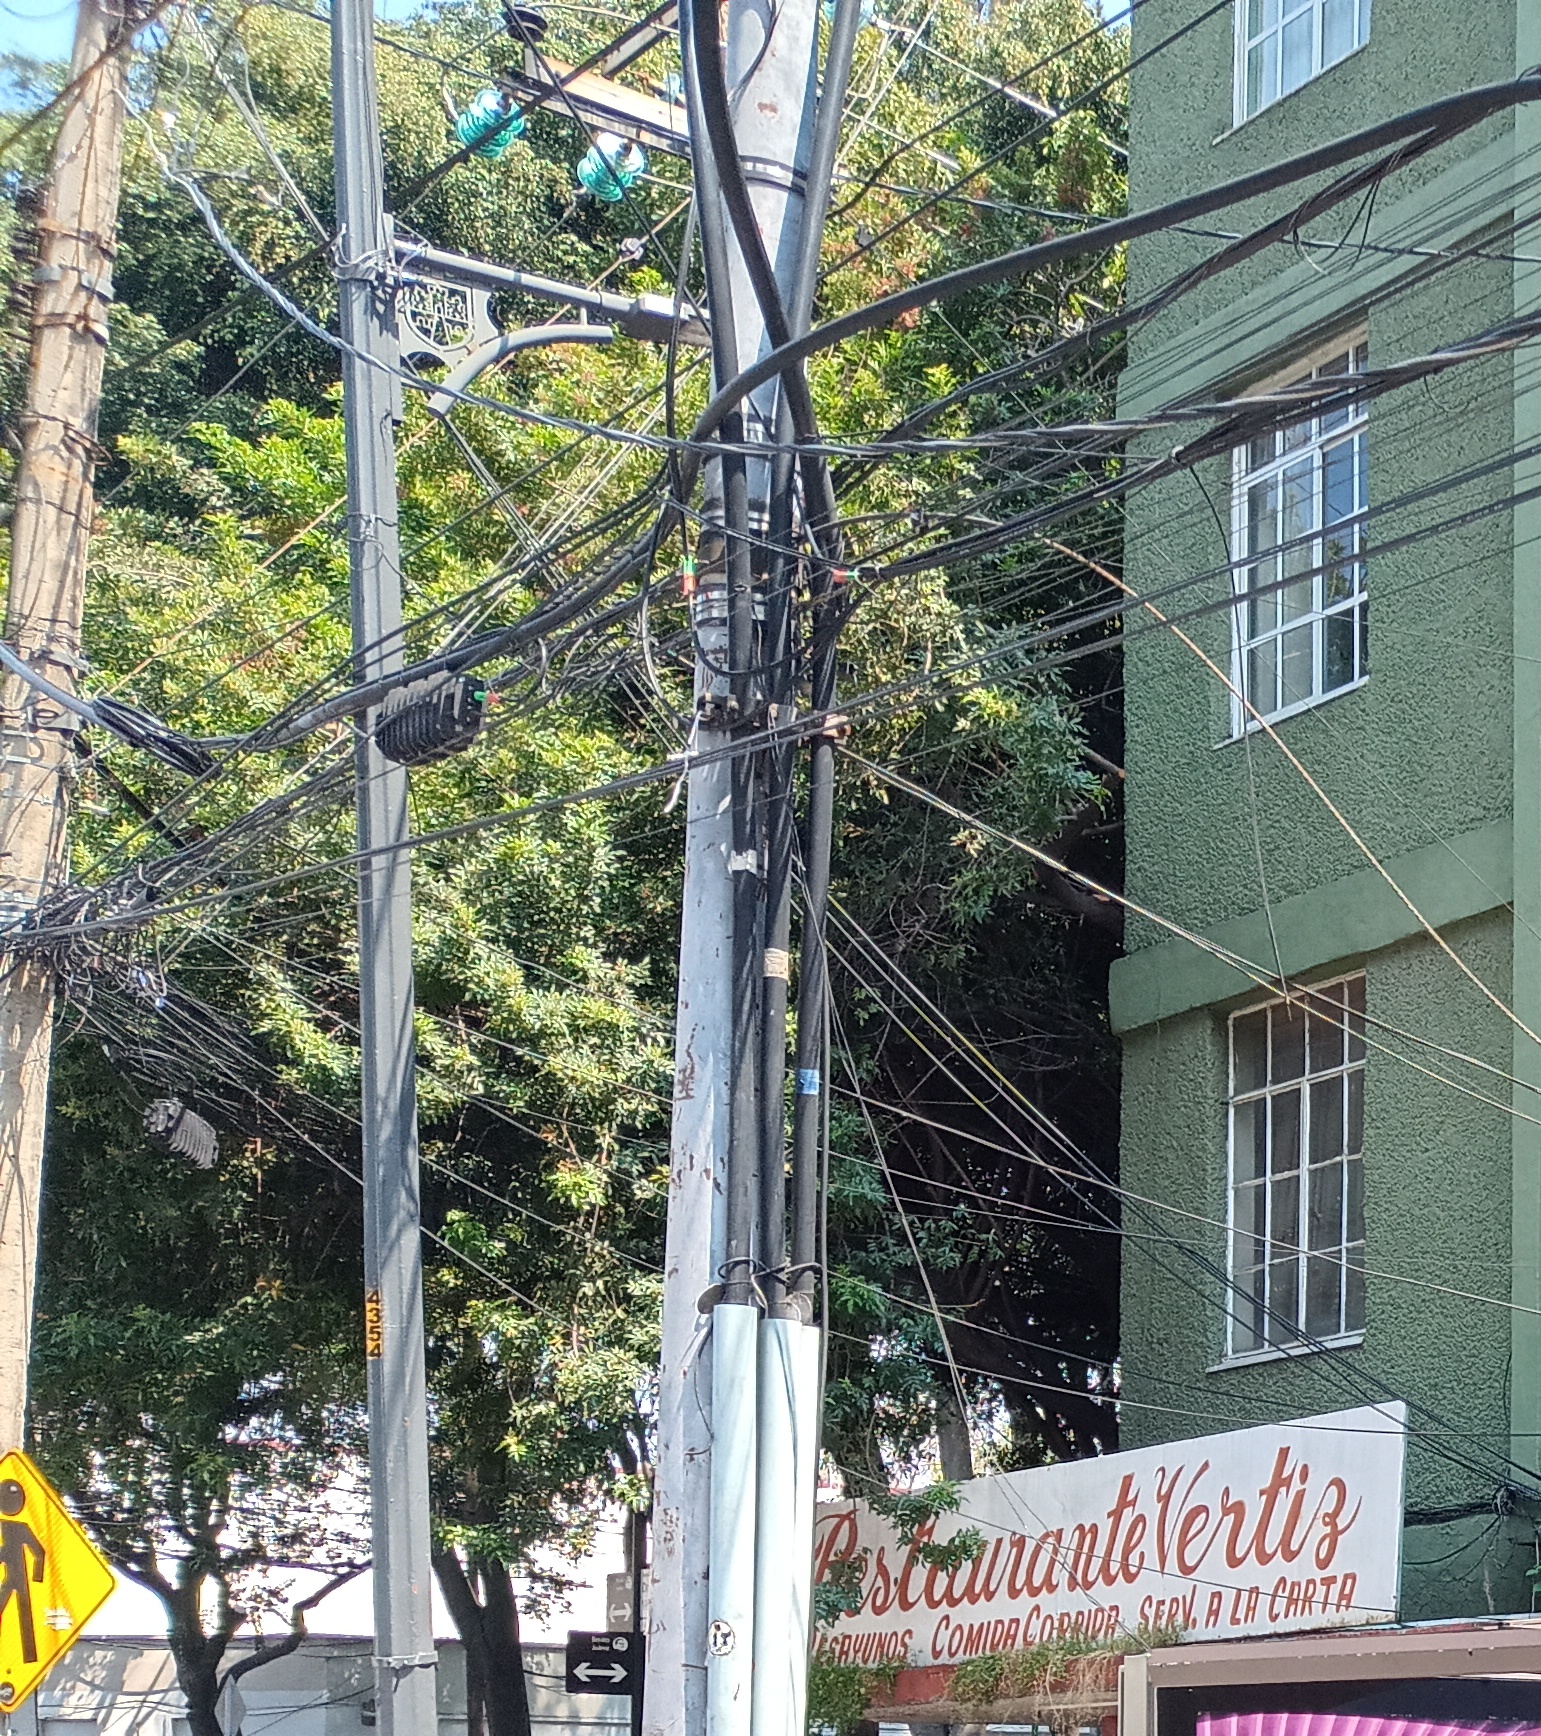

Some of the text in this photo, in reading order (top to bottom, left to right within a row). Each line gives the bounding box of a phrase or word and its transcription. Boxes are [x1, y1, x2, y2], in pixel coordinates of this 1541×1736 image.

[367, 1289, 382, 1358] 4354
[1153, 1445, 1363, 1576] Vertiz
[811, 1628, 914, 1665] ESAYUNOS
[931, 1613, 1016, 1661] COMIDA
[1138, 1584, 1198, 1632] SERV.
[1205, 1600, 1222, 1629] A
[1229, 1586, 1261, 1626] LA
[1267, 1572, 1357, 1623] CARTA
